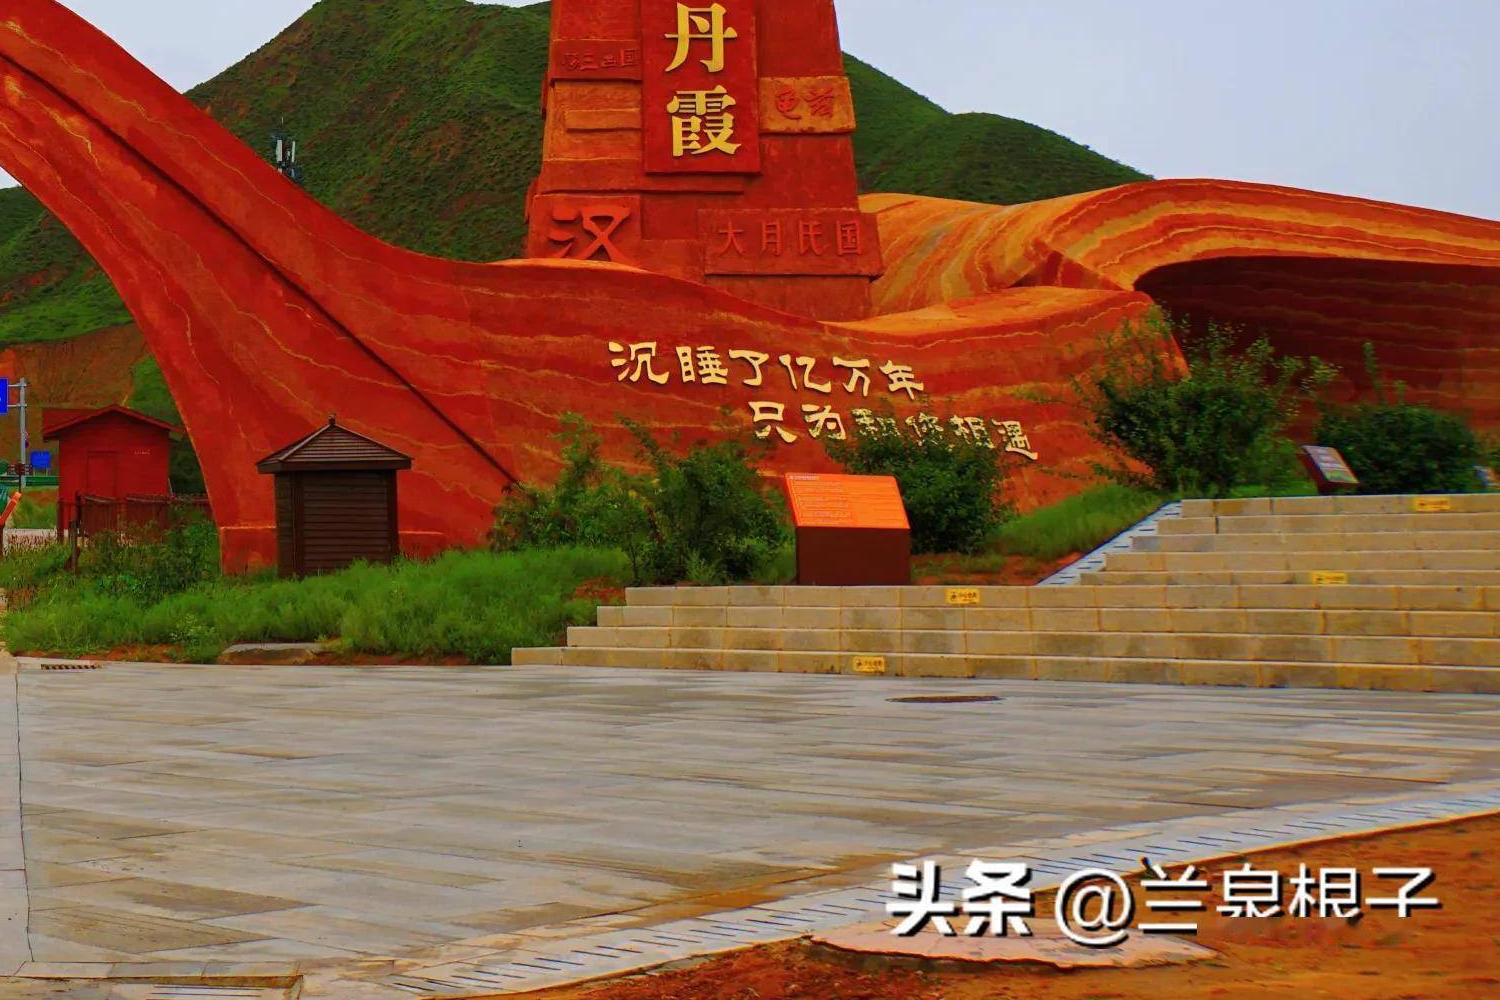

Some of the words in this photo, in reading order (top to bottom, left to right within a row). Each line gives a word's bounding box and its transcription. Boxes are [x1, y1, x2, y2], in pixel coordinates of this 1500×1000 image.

[549, 204, 632, 262] 汉
[608, 341, 924, 400] 沉睡了亿万年
